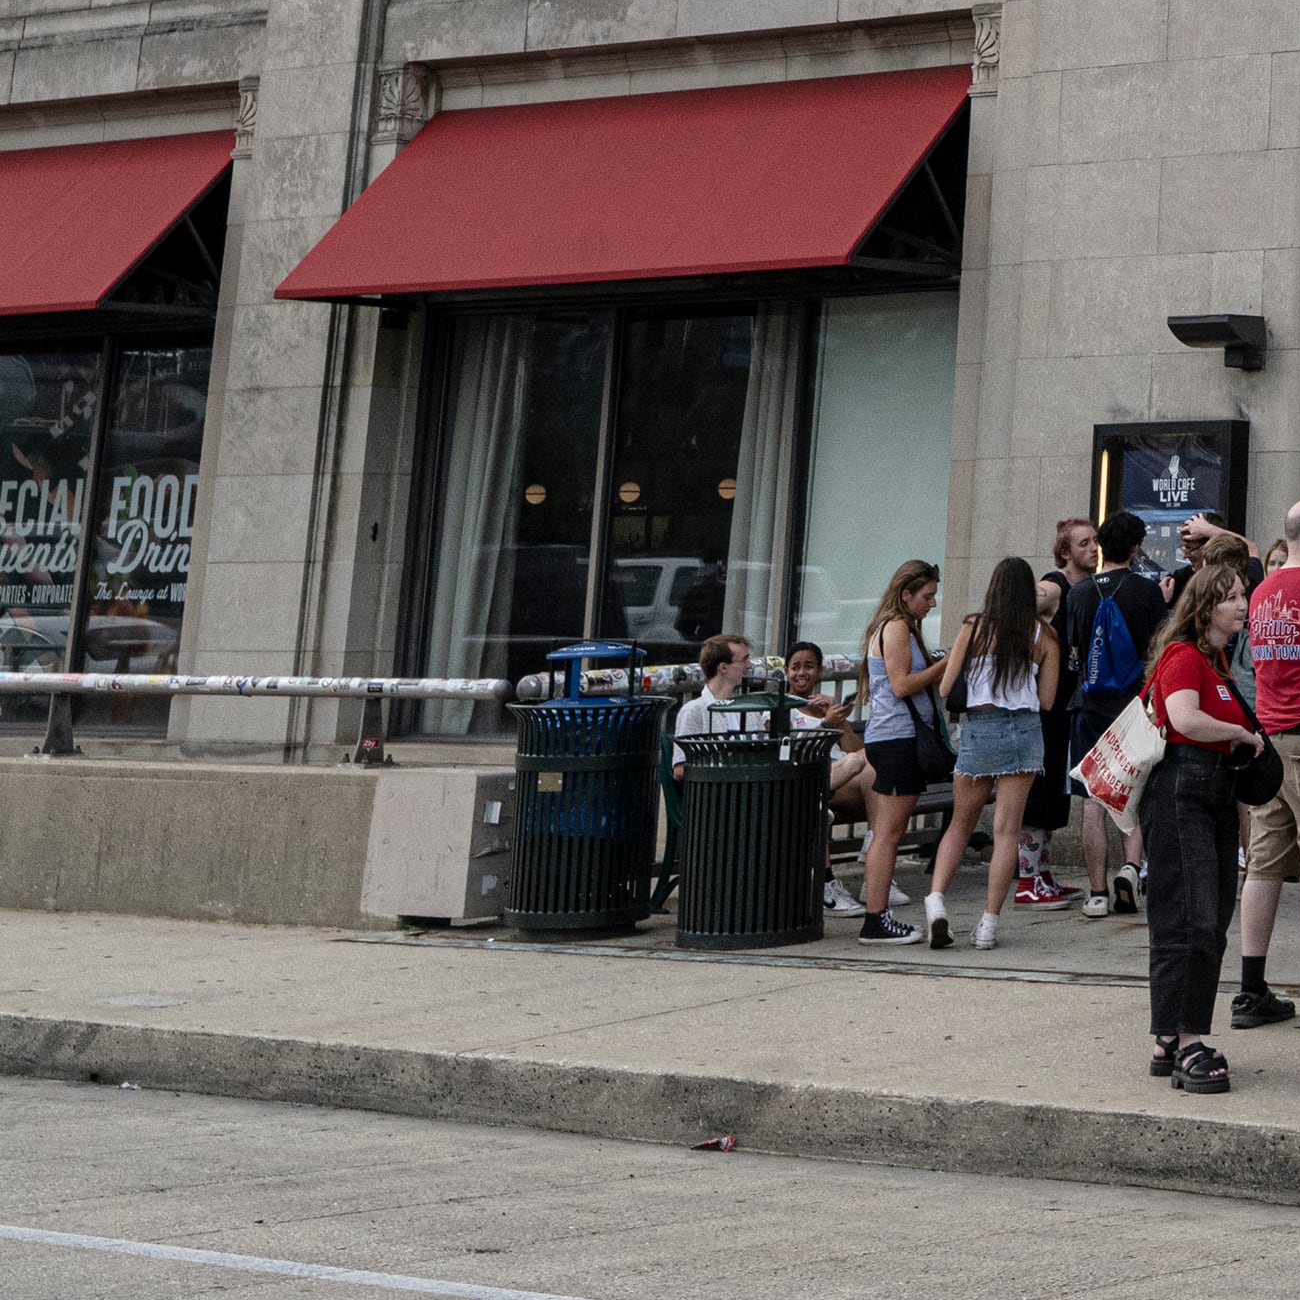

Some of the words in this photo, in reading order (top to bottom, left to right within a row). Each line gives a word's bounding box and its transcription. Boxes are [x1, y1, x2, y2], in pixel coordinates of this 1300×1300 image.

[1152, 478, 1176, 491] WORLD
[1177, 478, 1196, 491] CAFE
[1160, 491, 1189, 502] LIVE
[94, 581, 113, 600] The
[114, 581, 156, 605] Lounge
[157, 585, 168, 600] at
[1251, 618, 1300, 644] Philly
